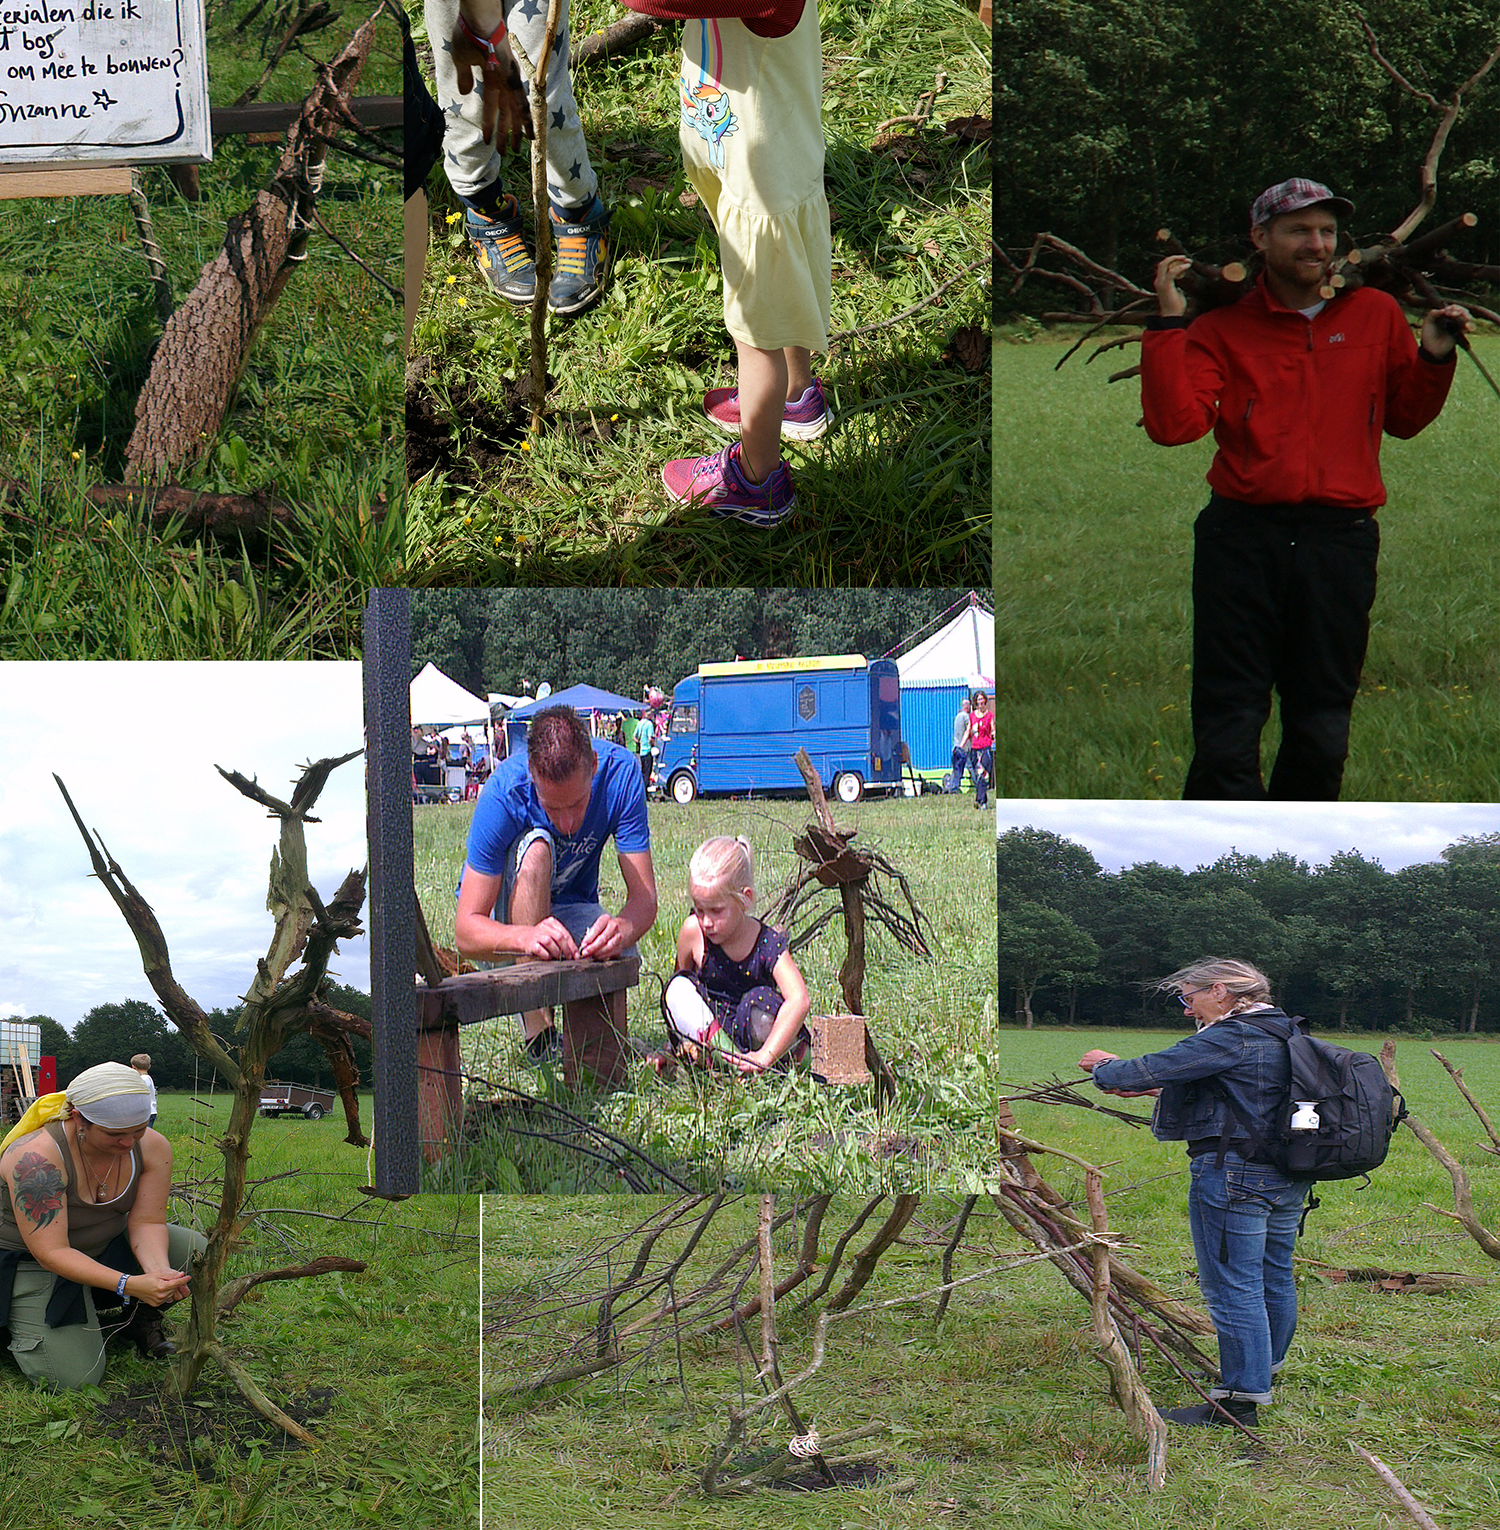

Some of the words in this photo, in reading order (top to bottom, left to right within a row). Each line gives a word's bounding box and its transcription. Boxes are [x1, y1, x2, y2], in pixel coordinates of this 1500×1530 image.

[83, 0, 114, 20] die
[81, 55, 98, 76] te
[485, 227, 508, 237] GEOX
[567, 225, 590, 235] GEOX
